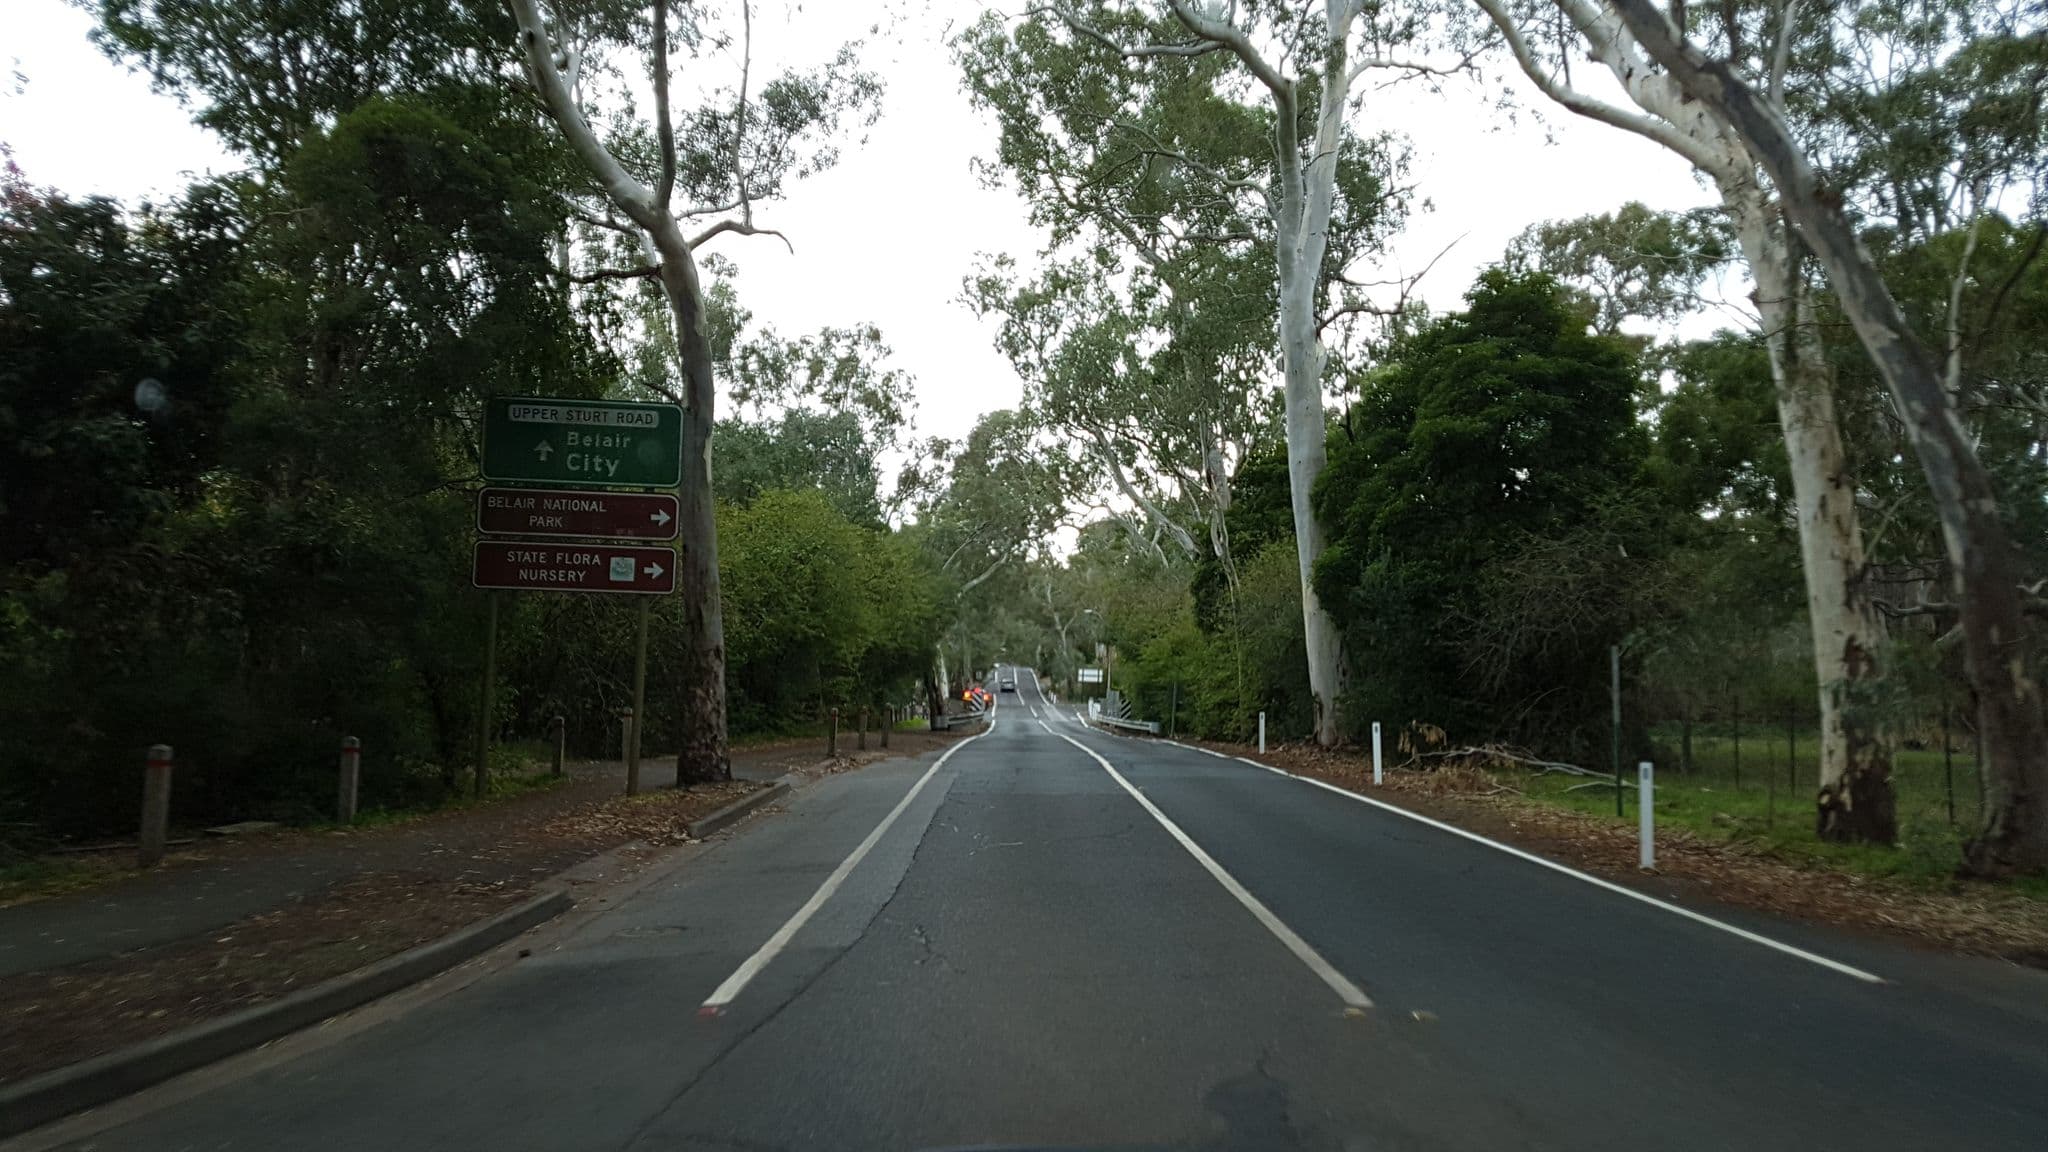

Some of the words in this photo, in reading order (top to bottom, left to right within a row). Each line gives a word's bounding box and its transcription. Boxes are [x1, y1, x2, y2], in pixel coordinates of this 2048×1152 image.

[512, 407, 558, 420] UPPER
[566, 409, 609, 423] STURT
[616, 411, 654, 425] ROAD
[567, 431, 631, 448] Belair
[566, 453, 620, 477] City
[487, 496, 536, 510] BELAIR
[543, 498, 607, 513] NATIONAL
[529, 515, 563, 528] PARK
[507, 551, 547, 564] STATE
[556, 552, 601, 566] FLORA
[519, 569, 587, 582] NURSERY
